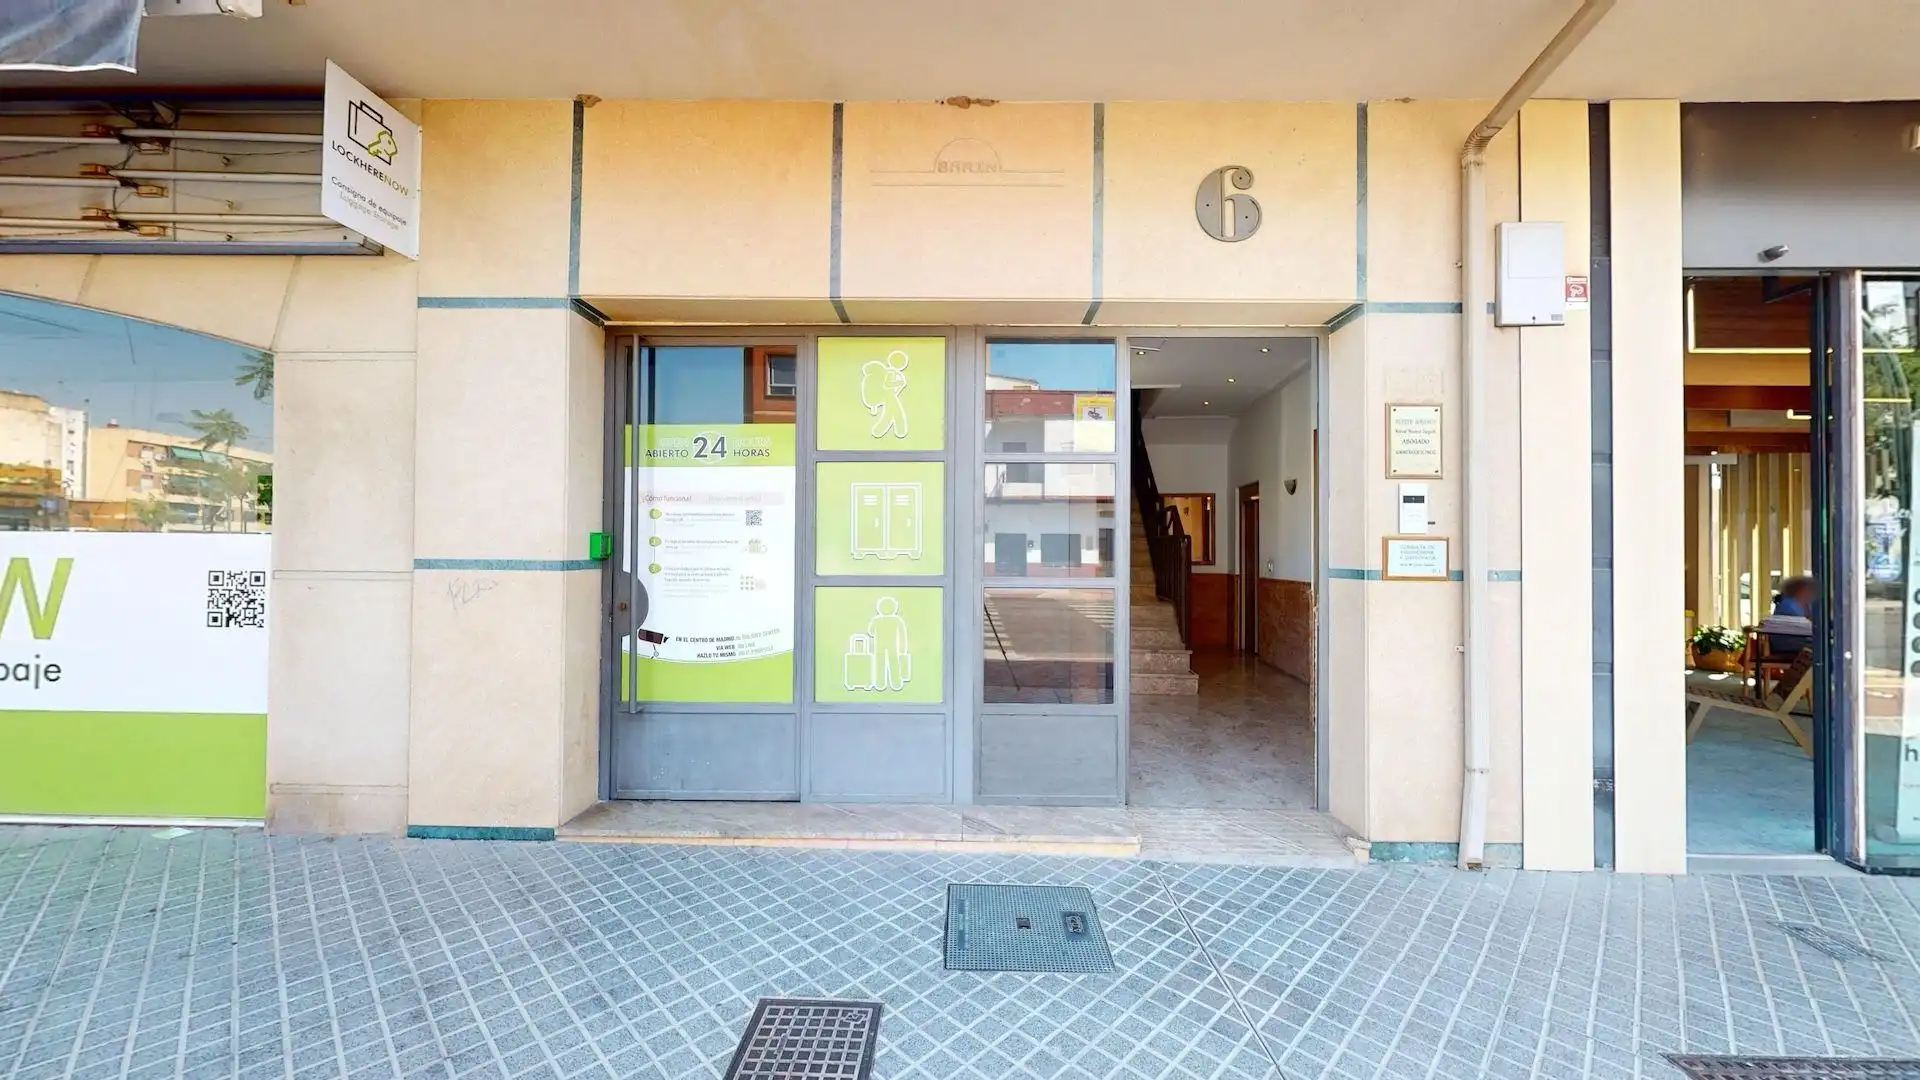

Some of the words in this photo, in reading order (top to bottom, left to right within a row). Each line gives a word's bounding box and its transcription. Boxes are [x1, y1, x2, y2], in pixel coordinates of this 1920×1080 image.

[332, 140, 409, 196] LOCKHERENOW
[331, 176, 366, 201] Consigna
[368, 198, 377, 209] de
[1195, 165, 1262, 243] 6
[645, 449, 689, 458] ABIERTO
[692, 436, 727, 458] 24
[733, 448, 771, 458] HORAS
